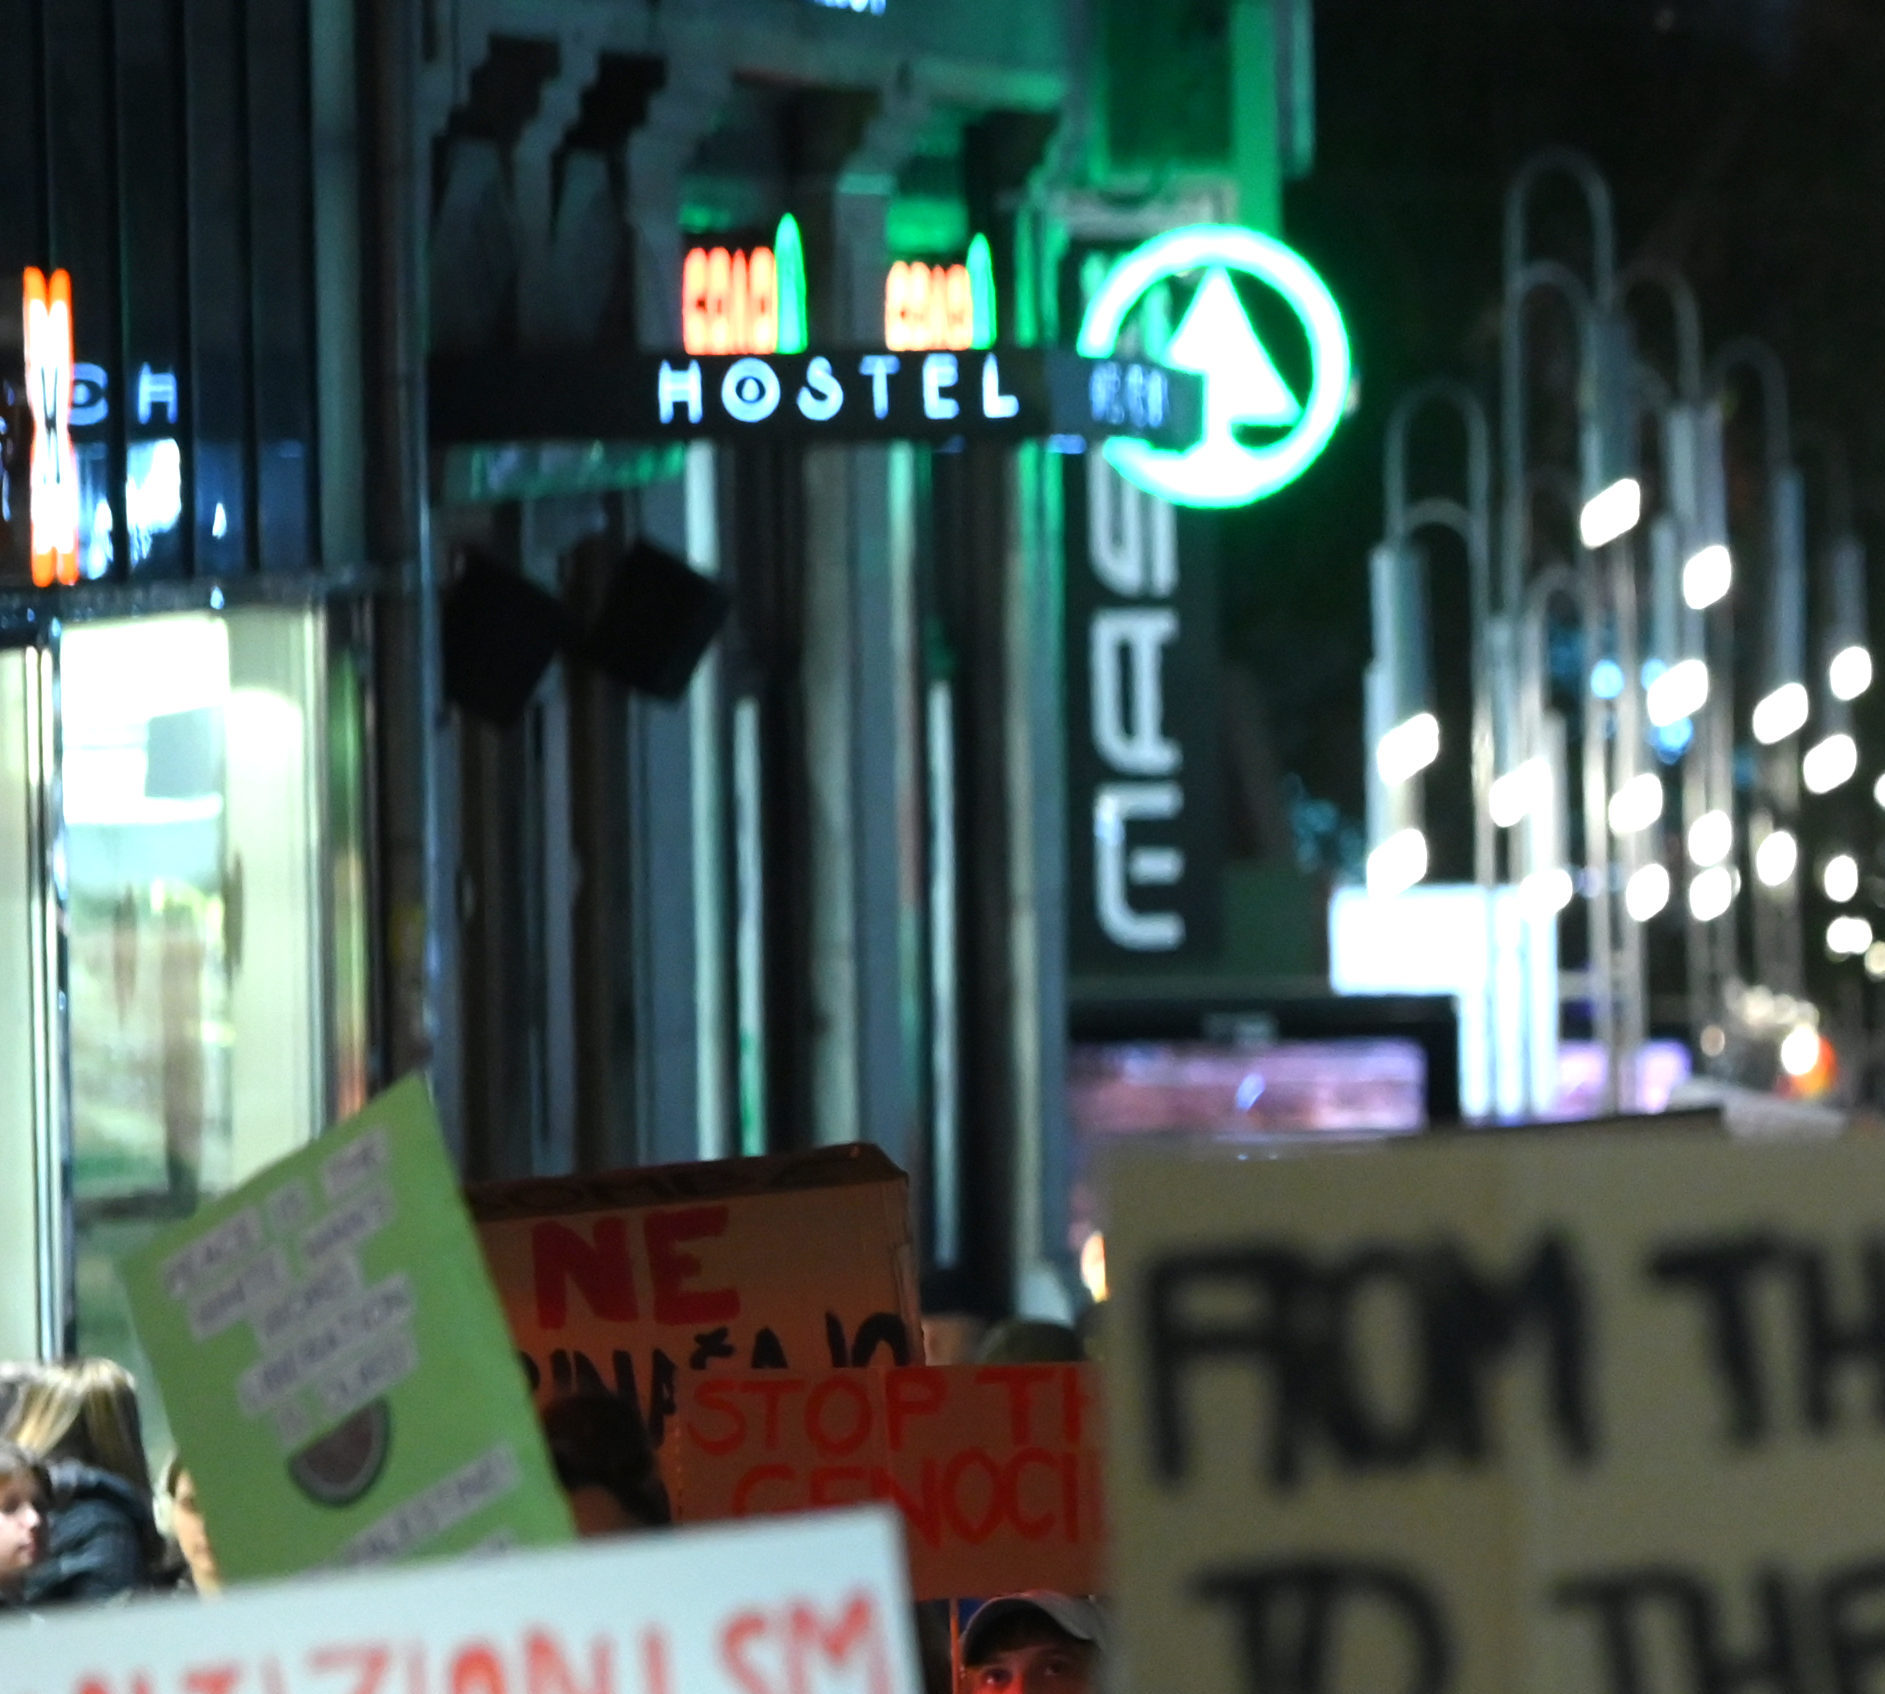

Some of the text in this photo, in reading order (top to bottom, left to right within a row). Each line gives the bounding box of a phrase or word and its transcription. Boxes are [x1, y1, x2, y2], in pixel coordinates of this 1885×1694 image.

[657, 352, 1020, 424] HOSTEL
[530, 1205, 740, 1331] NE
[687, 1362, 951, 1457] STOP
[1142, 1222, 1606, 1492] FROM
